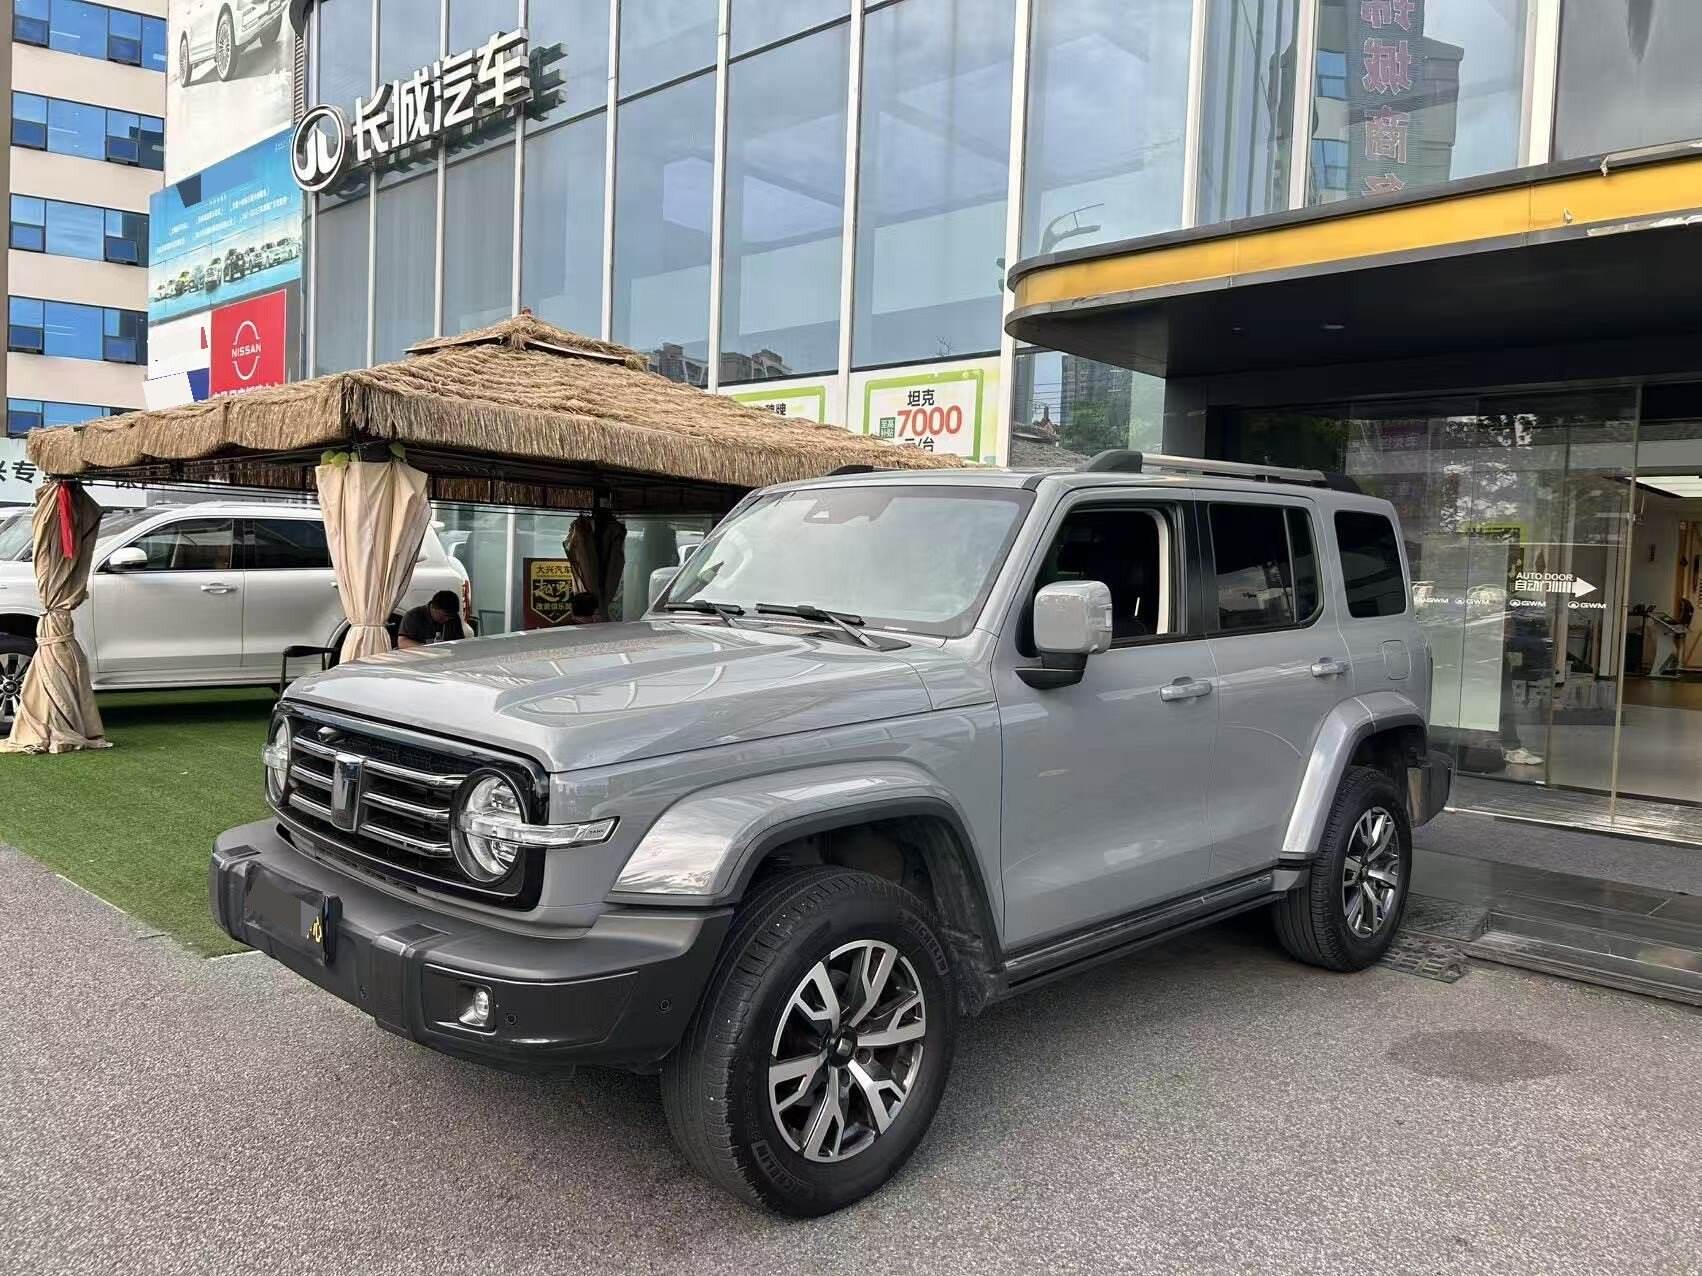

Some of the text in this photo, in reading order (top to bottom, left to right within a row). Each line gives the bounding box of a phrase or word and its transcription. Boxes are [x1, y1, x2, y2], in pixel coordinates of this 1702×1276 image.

[353, 28, 529, 161] 长城汽车
[231, 342, 262, 359] NISSAN
[907, 389, 935, 406] 坦克
[896, 405, 963, 438] 7000
[1516, 572, 1573, 581] AUTO DOOR
[1515, 580, 1552, 592] 自动门
